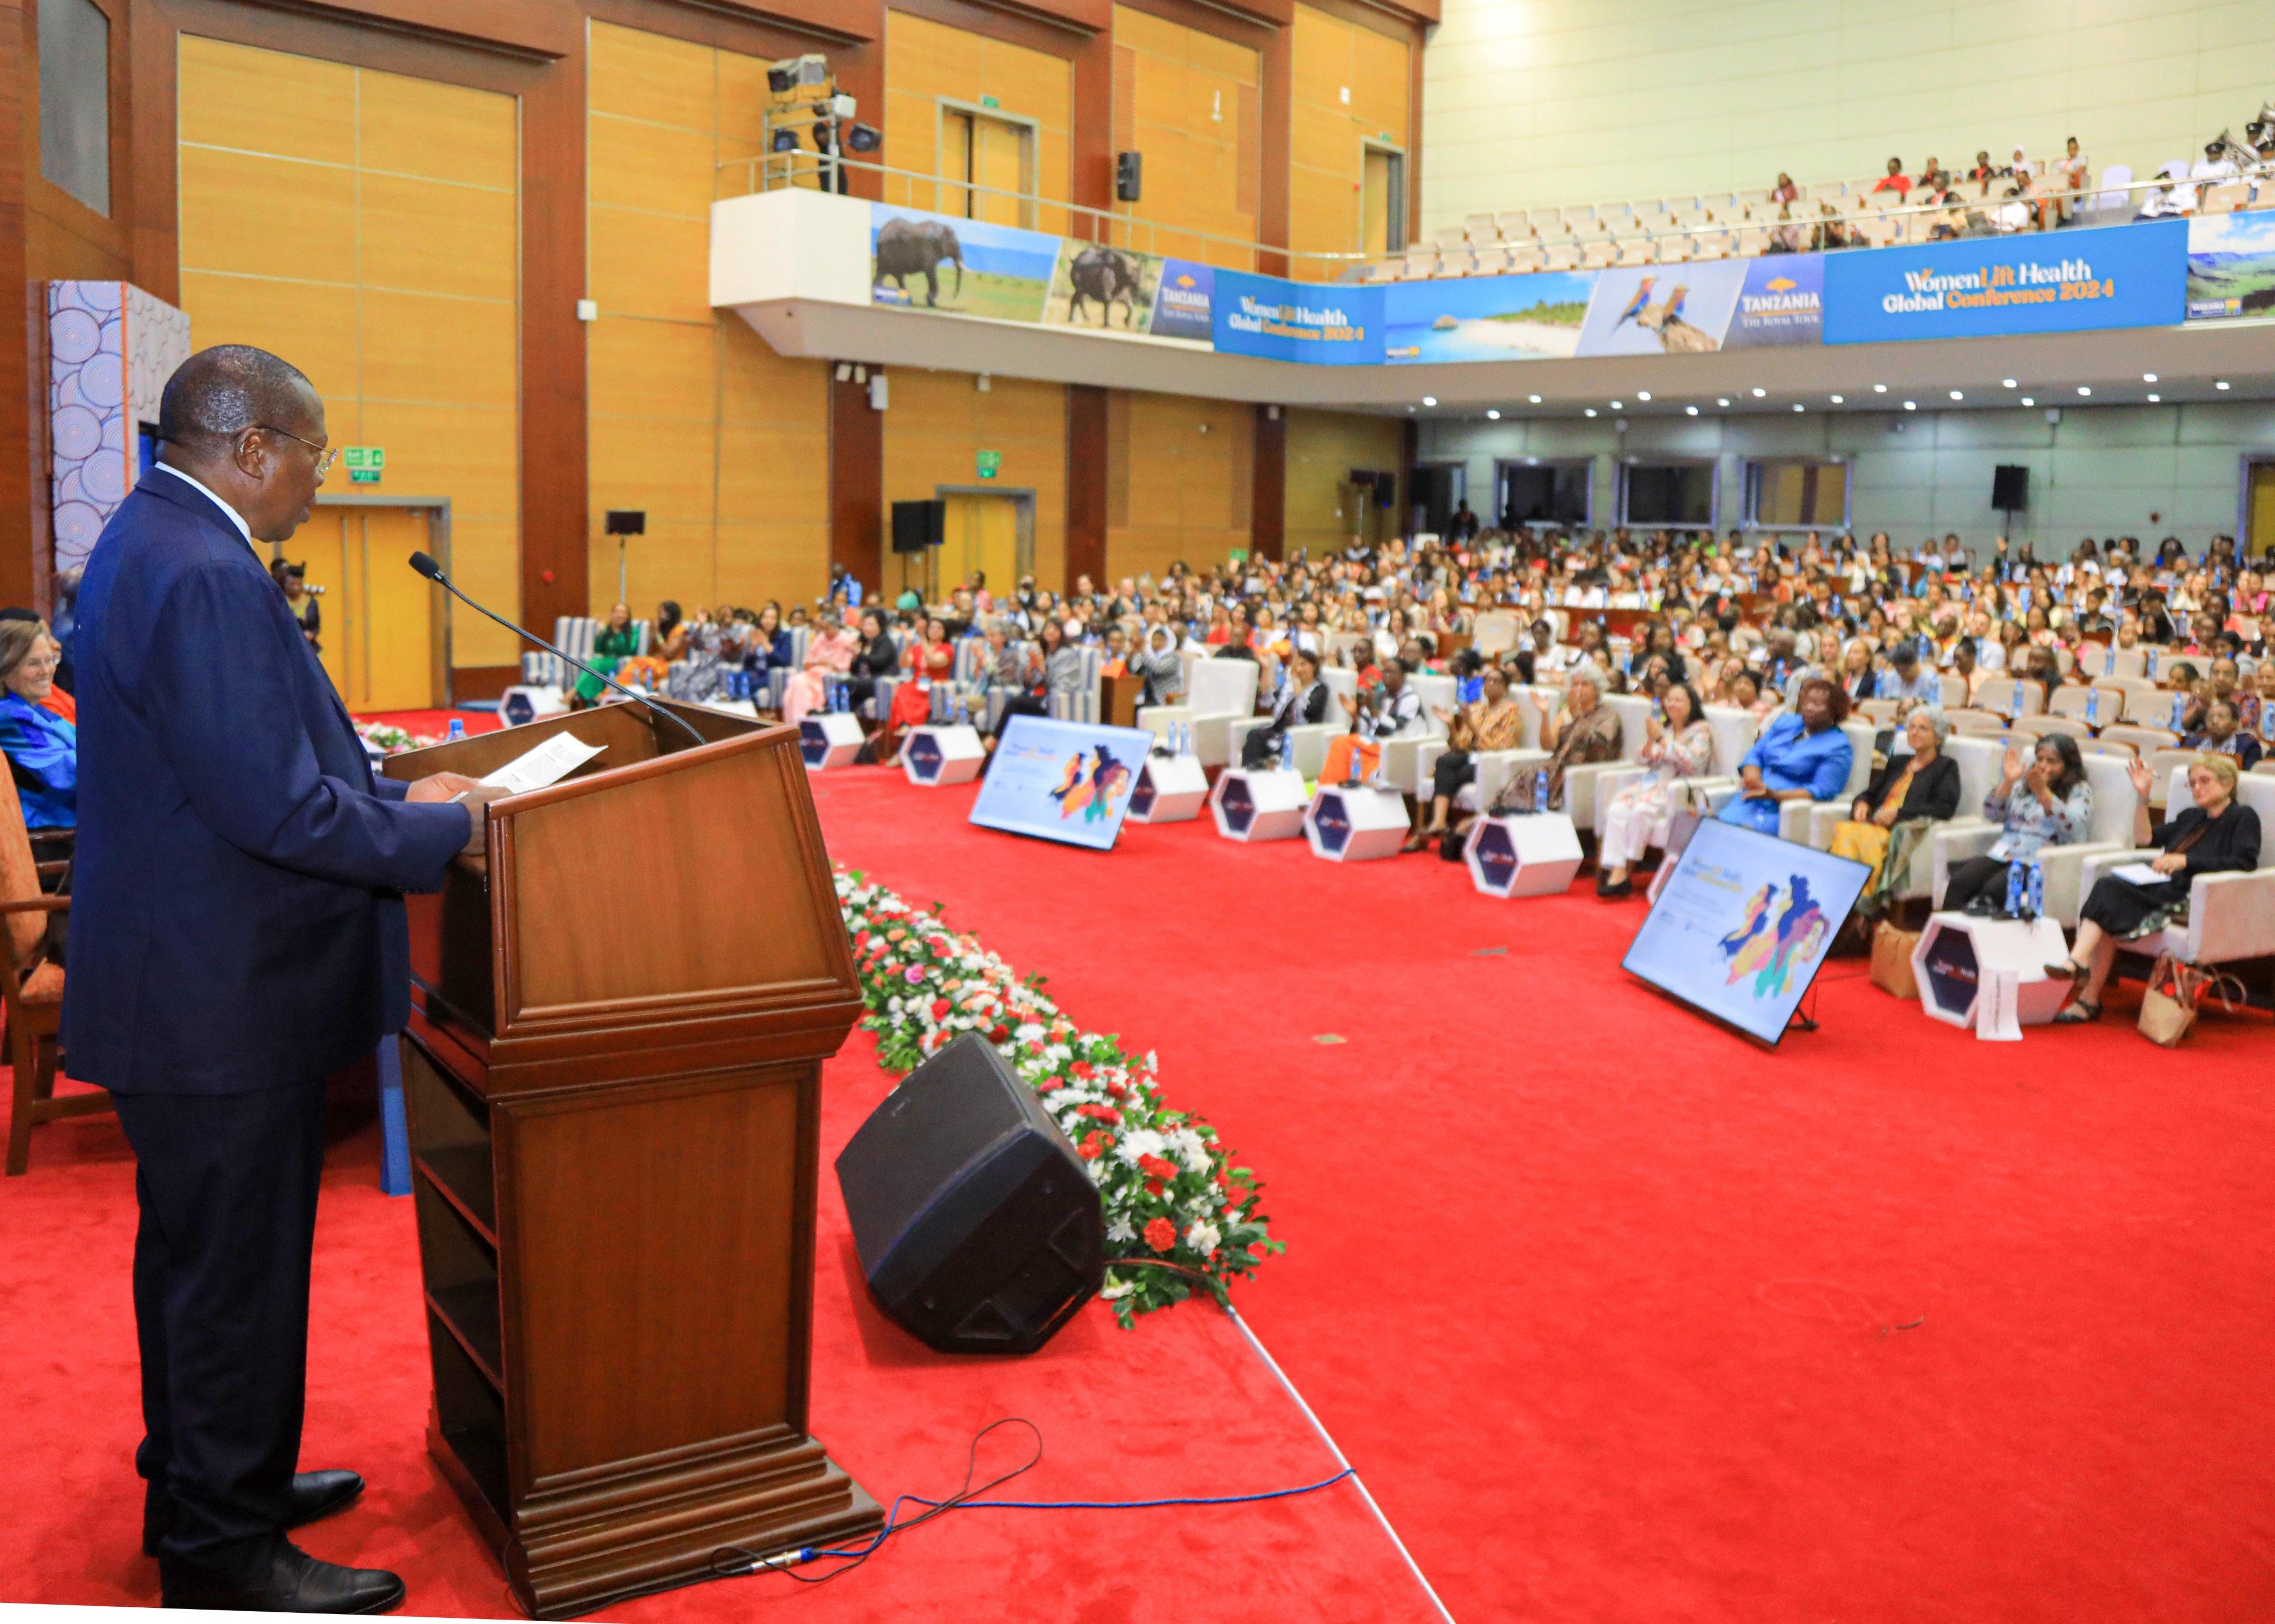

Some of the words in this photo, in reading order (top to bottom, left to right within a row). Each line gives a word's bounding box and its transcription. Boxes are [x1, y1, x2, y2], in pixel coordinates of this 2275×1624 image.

[2020, 258, 2092, 285] Health
[1161, 287, 1210, 308] TANZANIA
[1743, 292, 1821, 313] TANZANIA
[1882, 290, 1944, 314] Global
[1946, 288, 2056, 308] Conference
[2059, 277, 2114, 300] 2024
[1229, 313, 1261, 333] Global
[1322, 327, 1365, 341] 2024
[1296, 307, 1348, 327] Health
